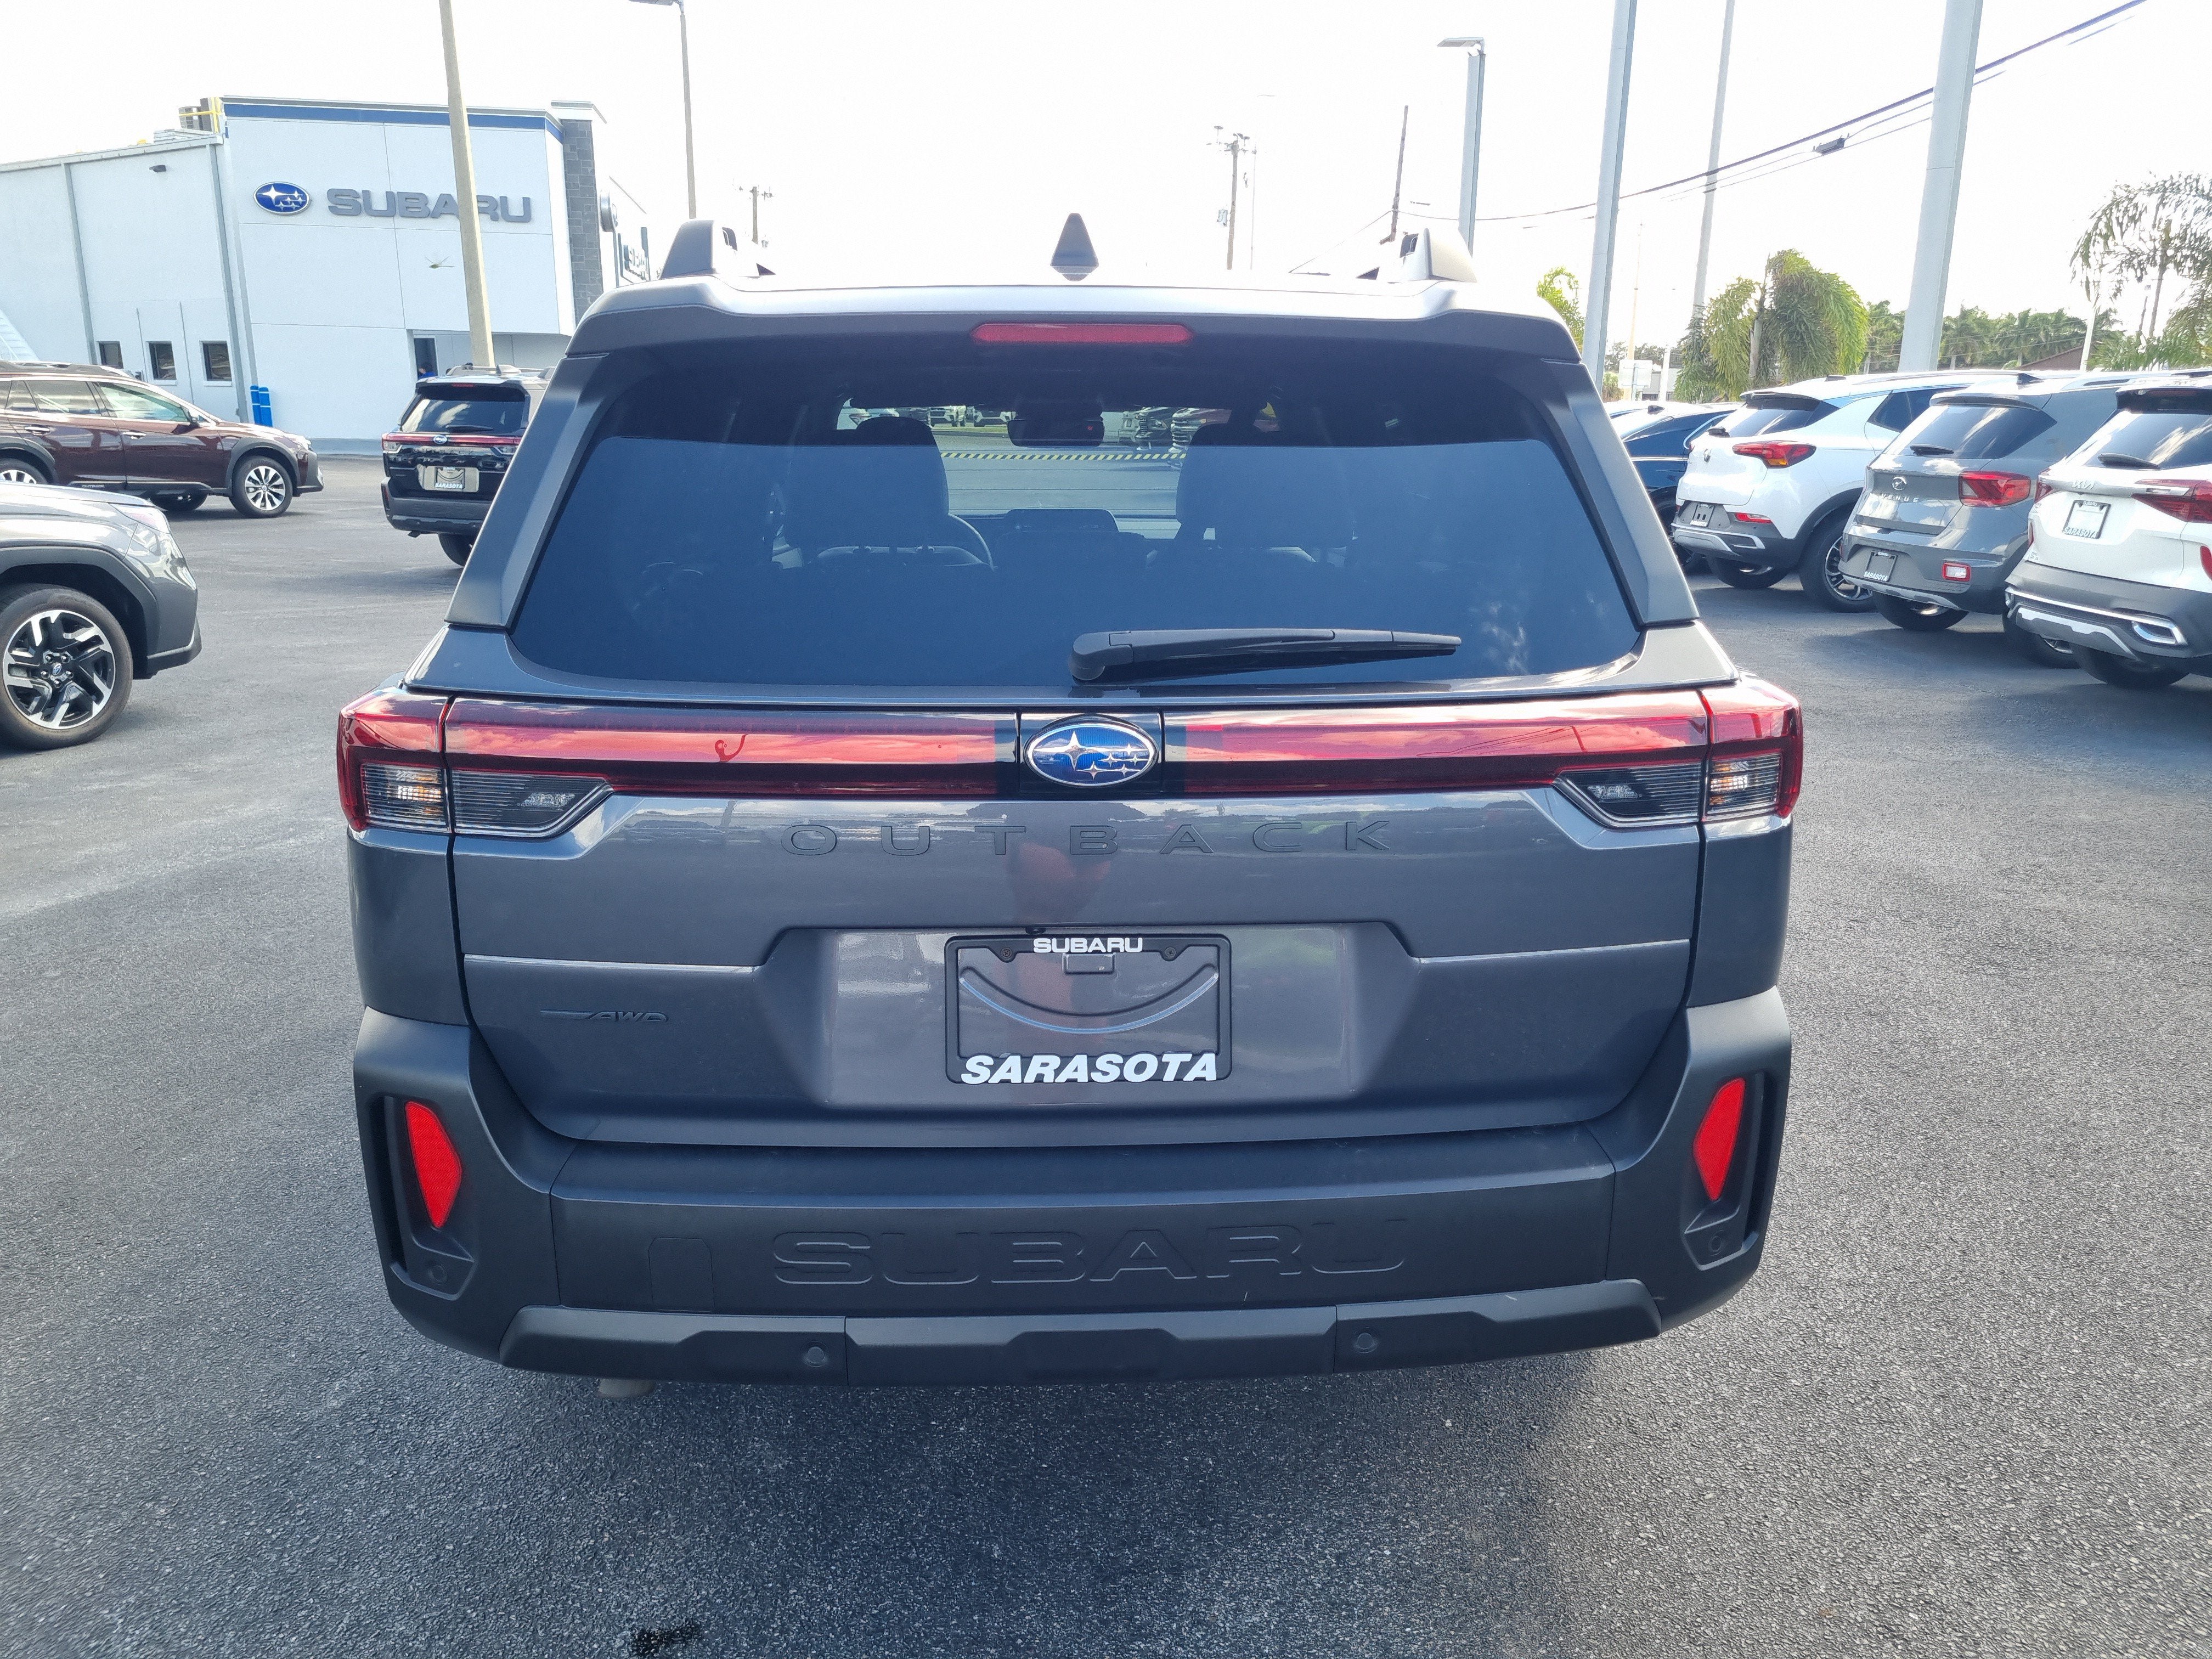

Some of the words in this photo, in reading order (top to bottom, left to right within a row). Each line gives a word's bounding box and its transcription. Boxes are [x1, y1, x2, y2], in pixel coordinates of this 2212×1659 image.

[327, 188, 531, 222] SUBARU
[1881, 494, 1919, 503] VENUE
[2063, 527, 2096, 539] SARASOTA
[1864, 571, 1888, 582] SARASOTA
[781, 821, 1390, 856] OUTBACK
[1033, 938, 1143, 953] SUBARU
[582, 1010, 669, 1023] AWD
[961, 1053, 1216, 1084] SARASOTA
[772, 1218, 1408, 1285] SUBARU
